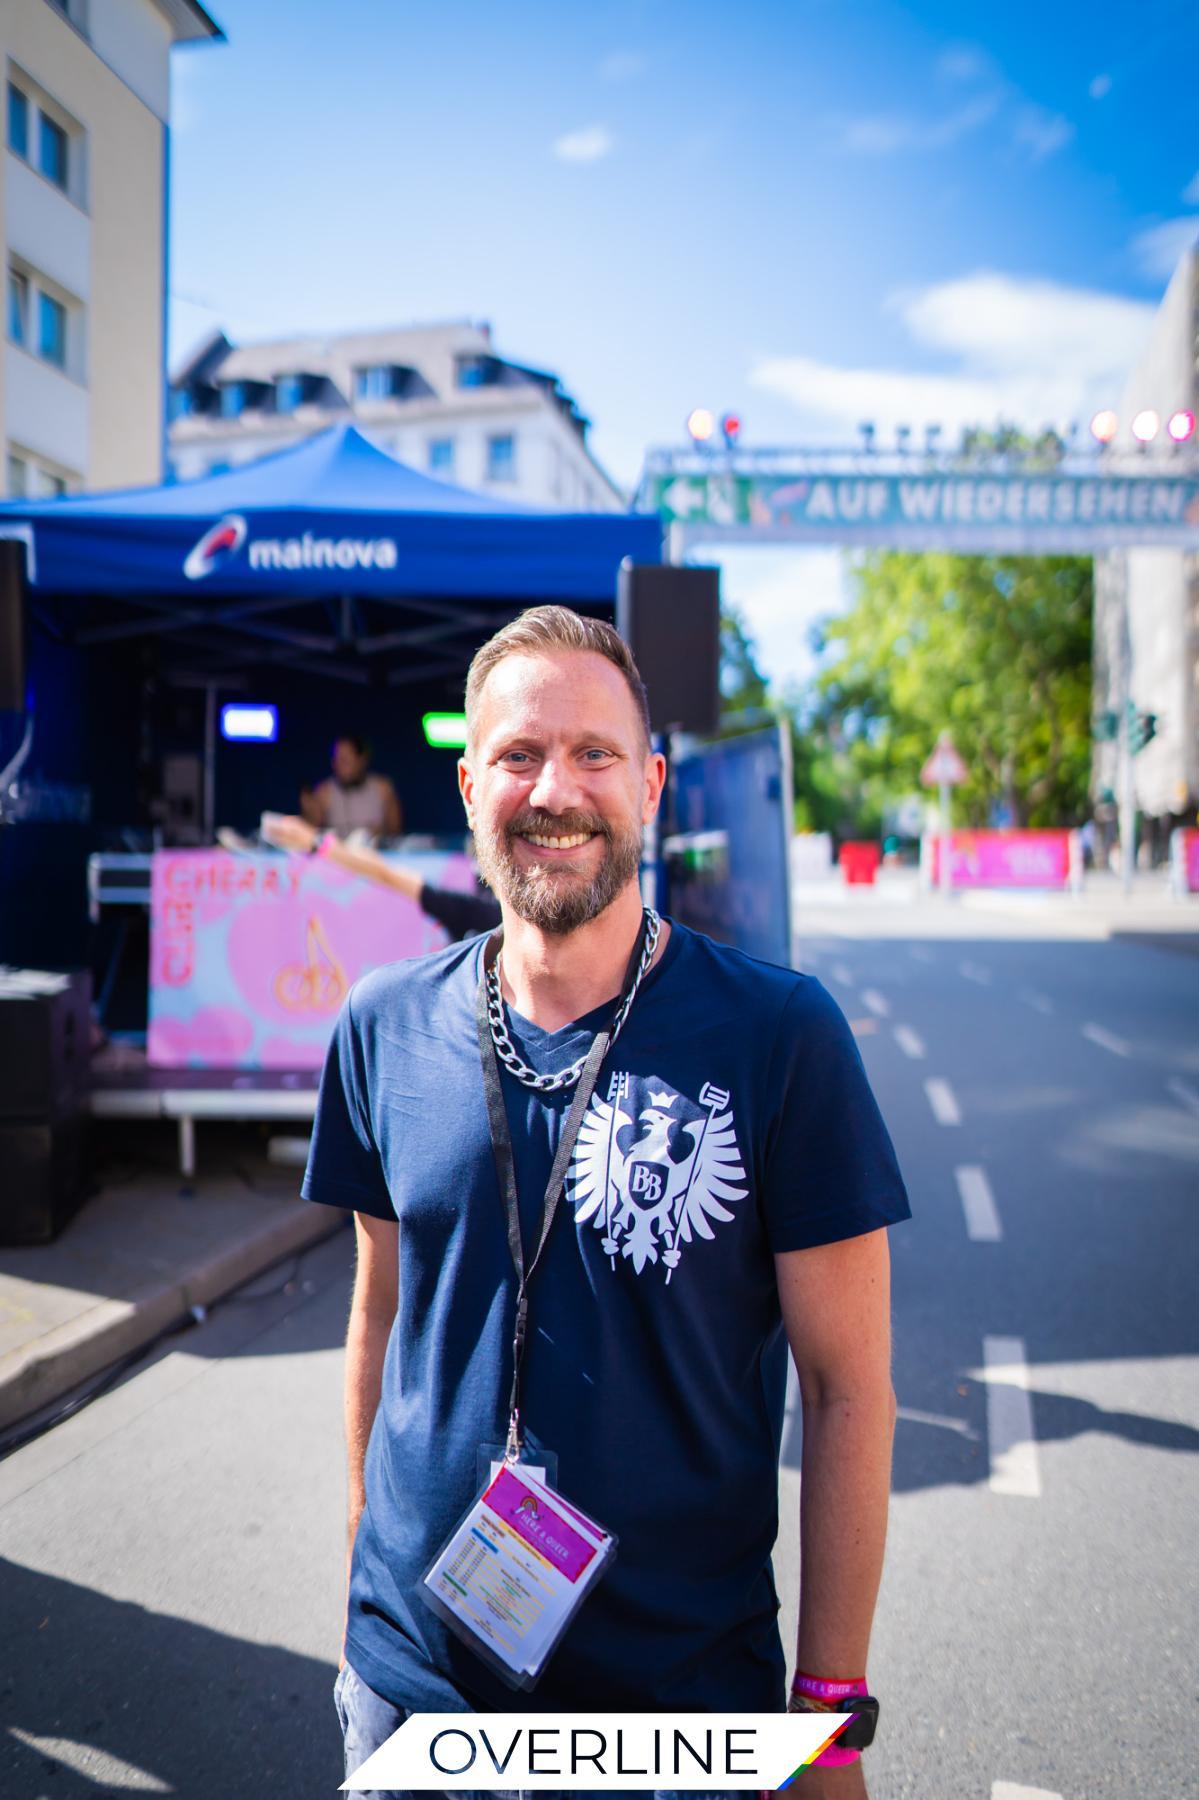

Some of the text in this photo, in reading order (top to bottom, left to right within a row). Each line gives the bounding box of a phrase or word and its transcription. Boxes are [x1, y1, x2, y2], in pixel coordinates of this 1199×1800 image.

[805, 480, 1184, 521] AUF WIEDERSEHEN
[249, 531, 398, 570] mainova
[631, 1164, 662, 1201] BB
